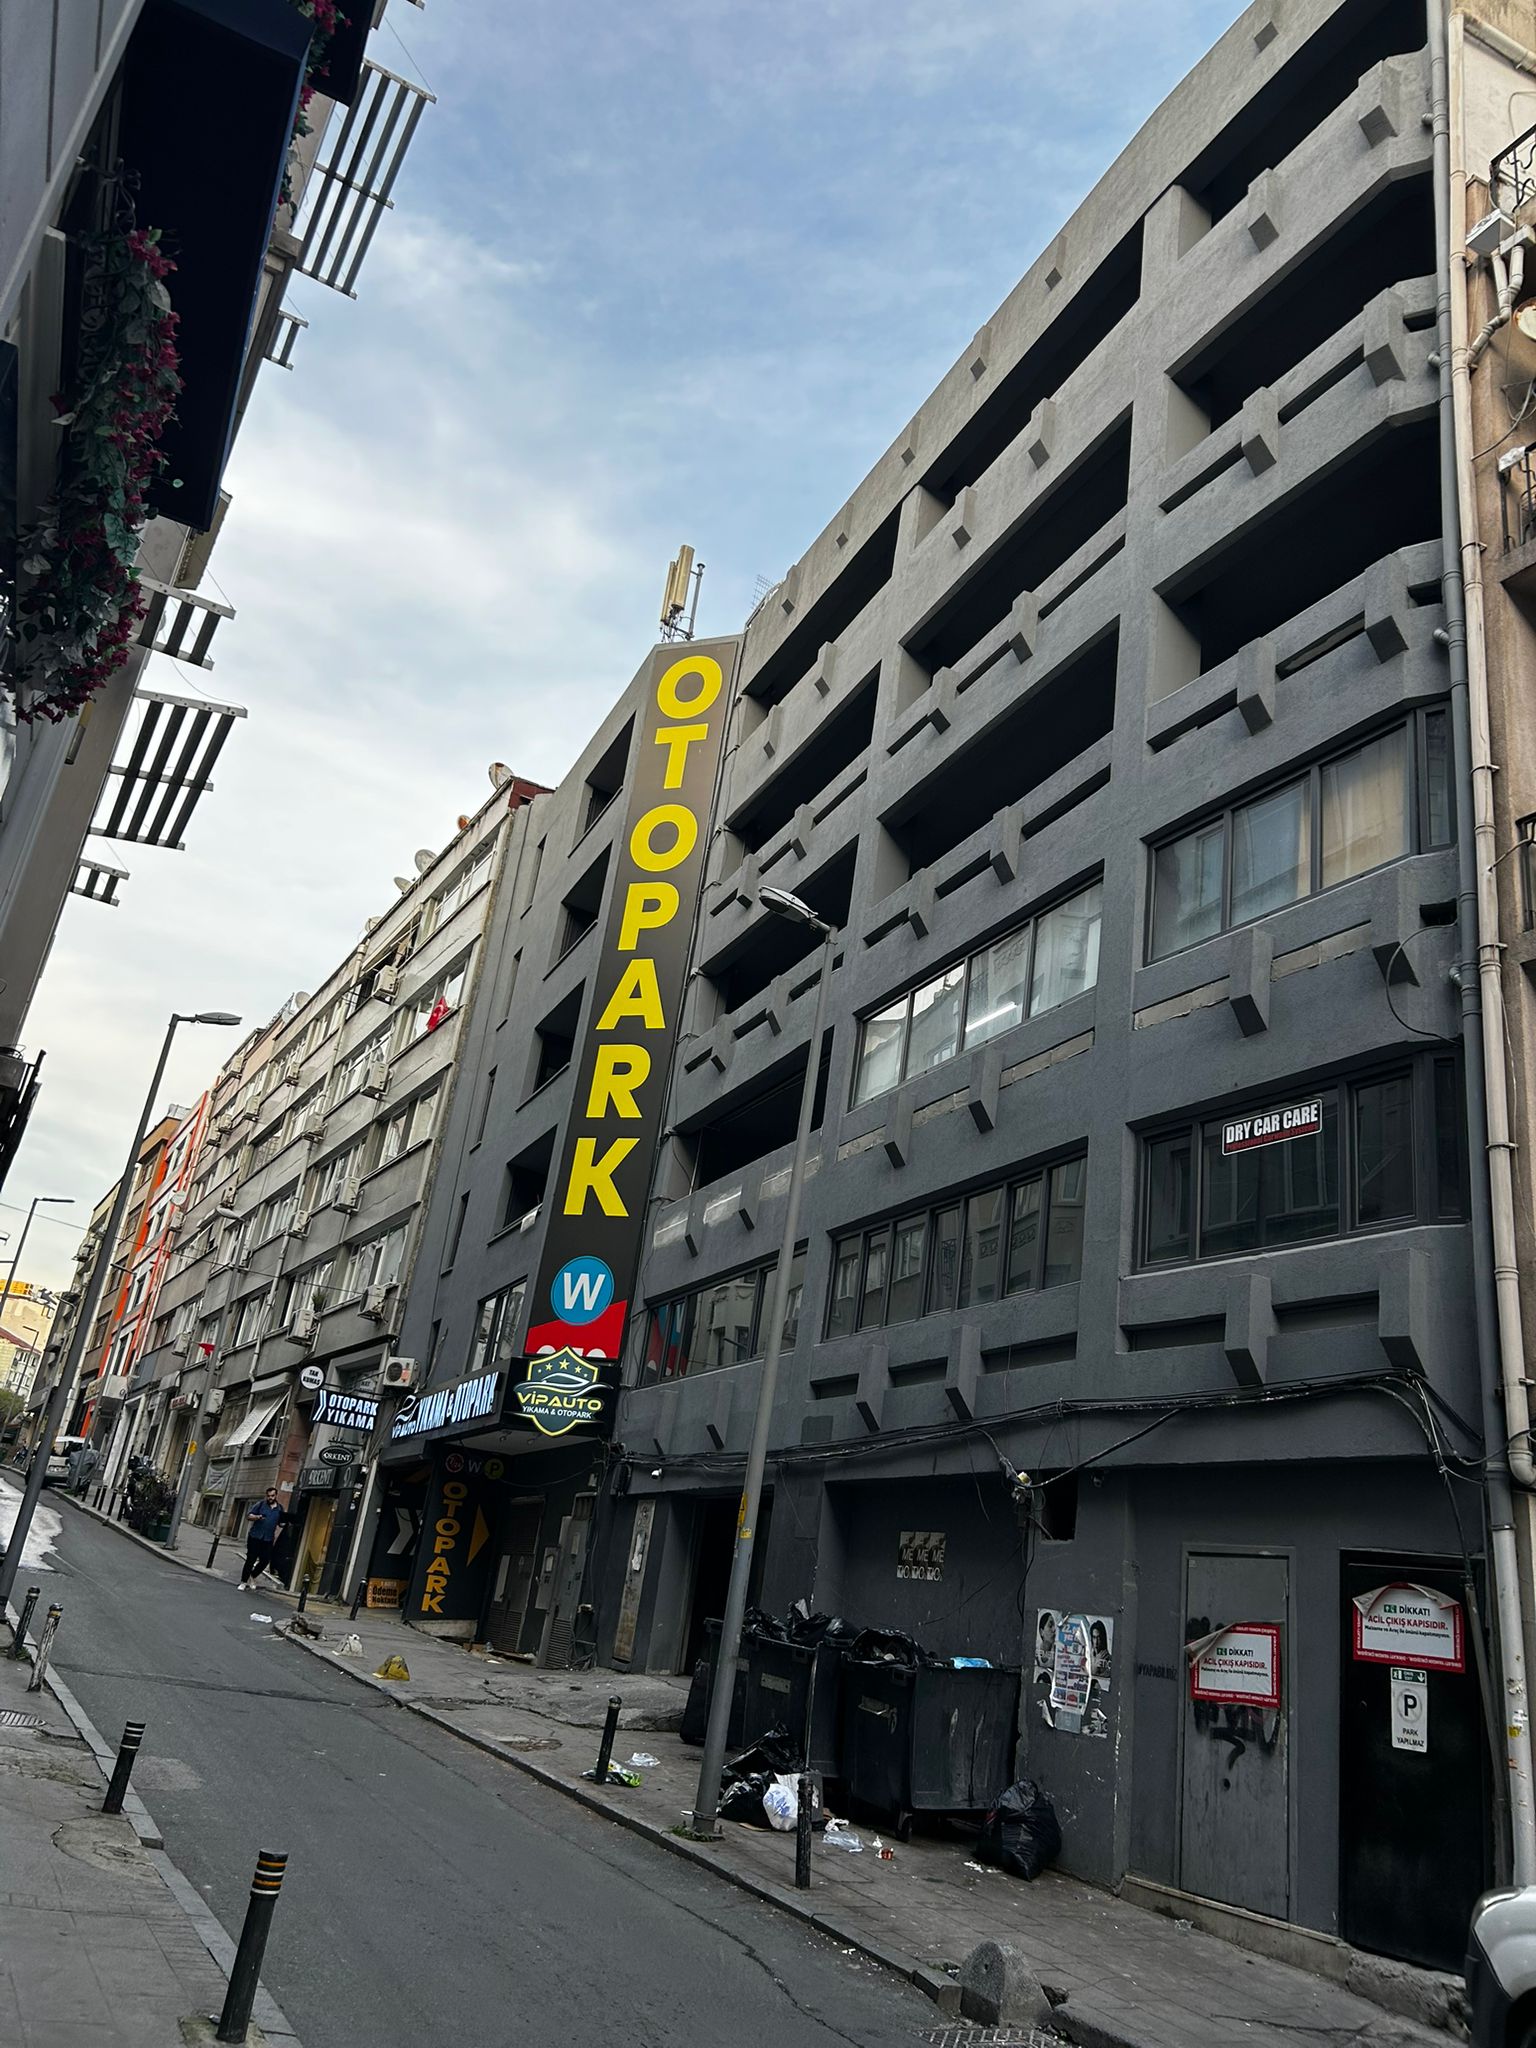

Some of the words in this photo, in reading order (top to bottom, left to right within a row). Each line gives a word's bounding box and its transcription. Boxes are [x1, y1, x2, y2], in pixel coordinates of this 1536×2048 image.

[562, 655, 723, 1218] OTOPARK
[1226, 1121, 1251, 1144] DRY
[1253, 1113, 1280, 1136] CAR
[1282, 1104, 1318, 1128] CARE
[563, 1272, 606, 1311] W
[328, 1393, 379, 1416] OTOPARK
[415, 1389, 450, 1433] YIKAMA
[451, 1371, 499, 1423] OTOPARK
[326, 1408, 375, 1430] YIKAMA
[522, 1405, 549, 1415] YIKAMA
[557, 1409, 592, 1419] OTOPARK
[323, 1453, 350, 1461] ORKENT
[420, 1481, 468, 1614] OTOPARK
[1399, 1605, 1430, 1616] DİKKAT!
[1368, 1614, 1385, 1623] ACİL
[1385, 1617, 1406, 1627] ÇIKIŞ
[1407, 1620, 1448, 1630] KAPISIDIR.
[1228, 1648, 1254, 1656] DİKKAT!
[1218, 1659, 1234, 1667] ÇIKIŞ
[1234, 1660, 1267, 1669] KAPISIDIR.
[1404, 1694, 1417, 1716] P
[1402, 1727, 1418, 1736] PARK
[1397, 1737, 1424, 1747] YAPILMAZ
